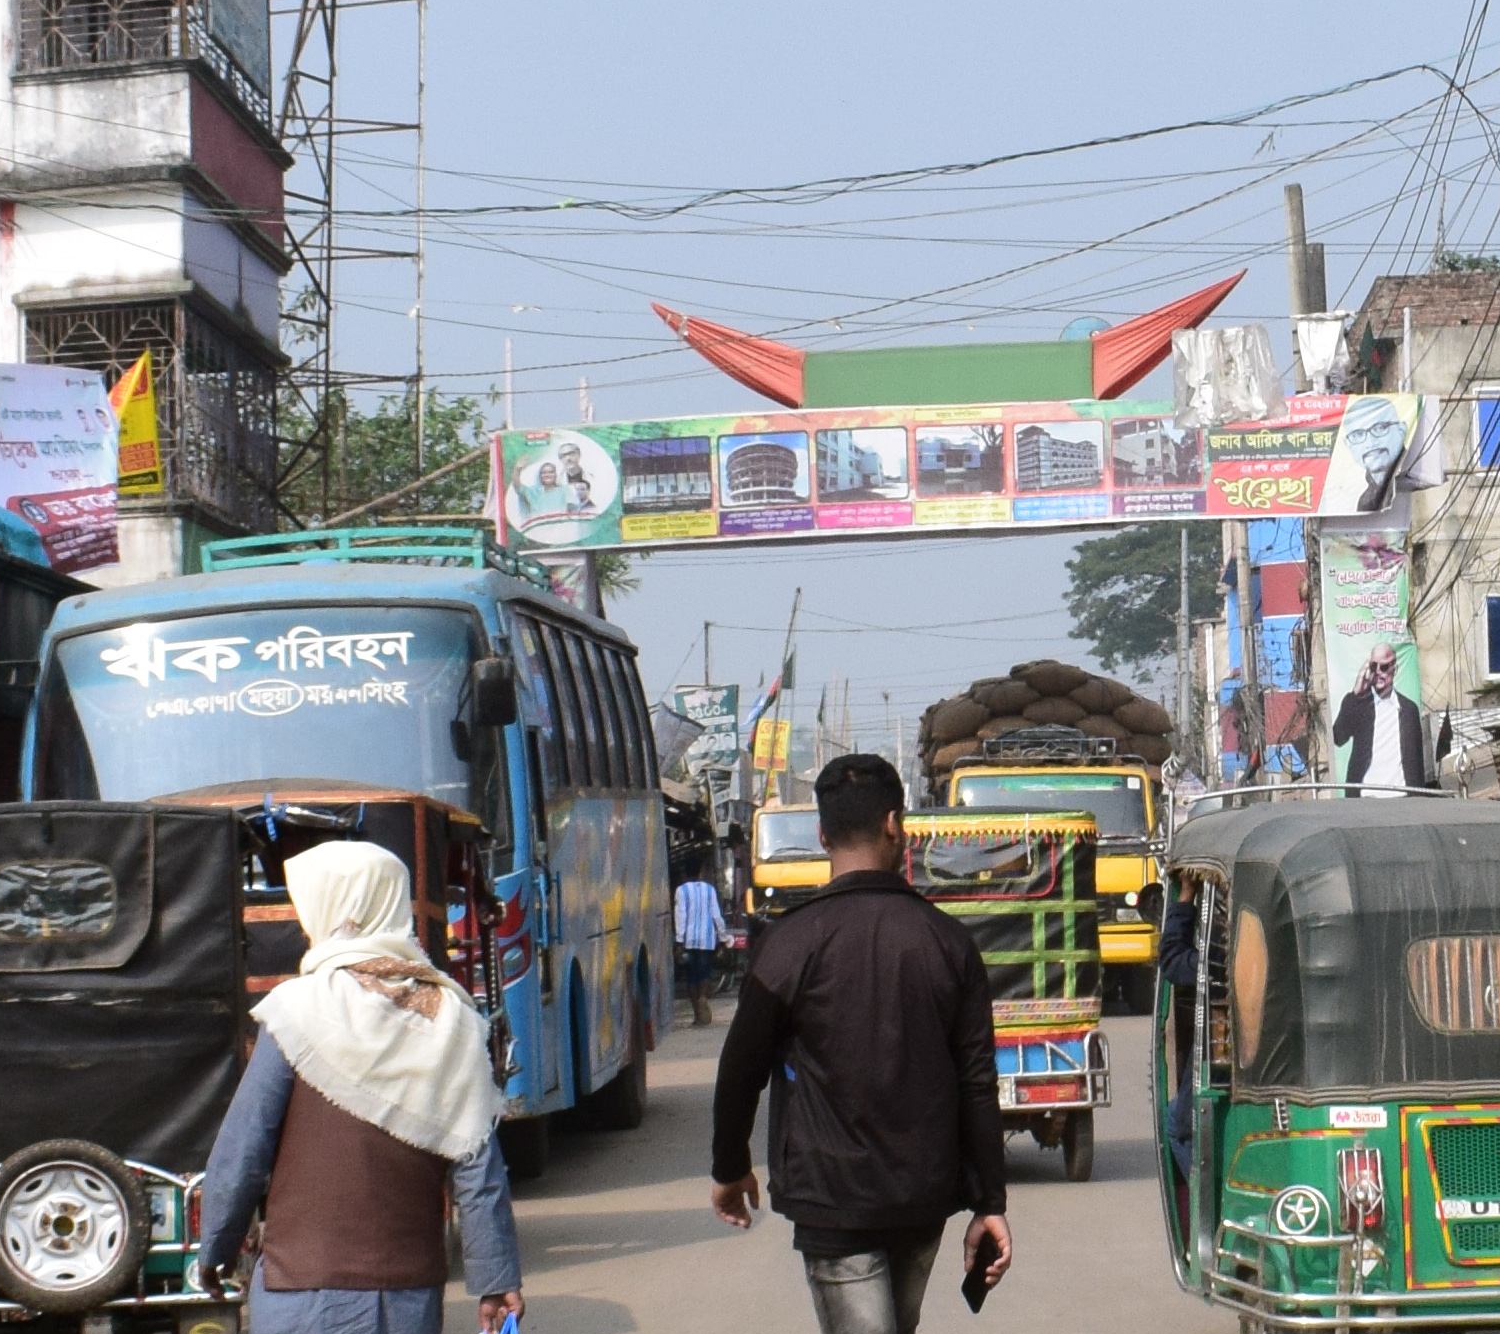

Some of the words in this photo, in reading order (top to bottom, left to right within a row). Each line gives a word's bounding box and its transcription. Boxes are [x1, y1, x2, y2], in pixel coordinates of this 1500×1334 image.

[1209, 434, 1241, 450] জনাব
[1245, 429, 1283, 449] আরিফ
[1287, 432, 1308, 448] খান
[1213, 476, 1314, 510] শুভেচ্ছা
[254, 625, 415, 672] পরিবহন
[248, 686, 293, 712] মহুয়া
